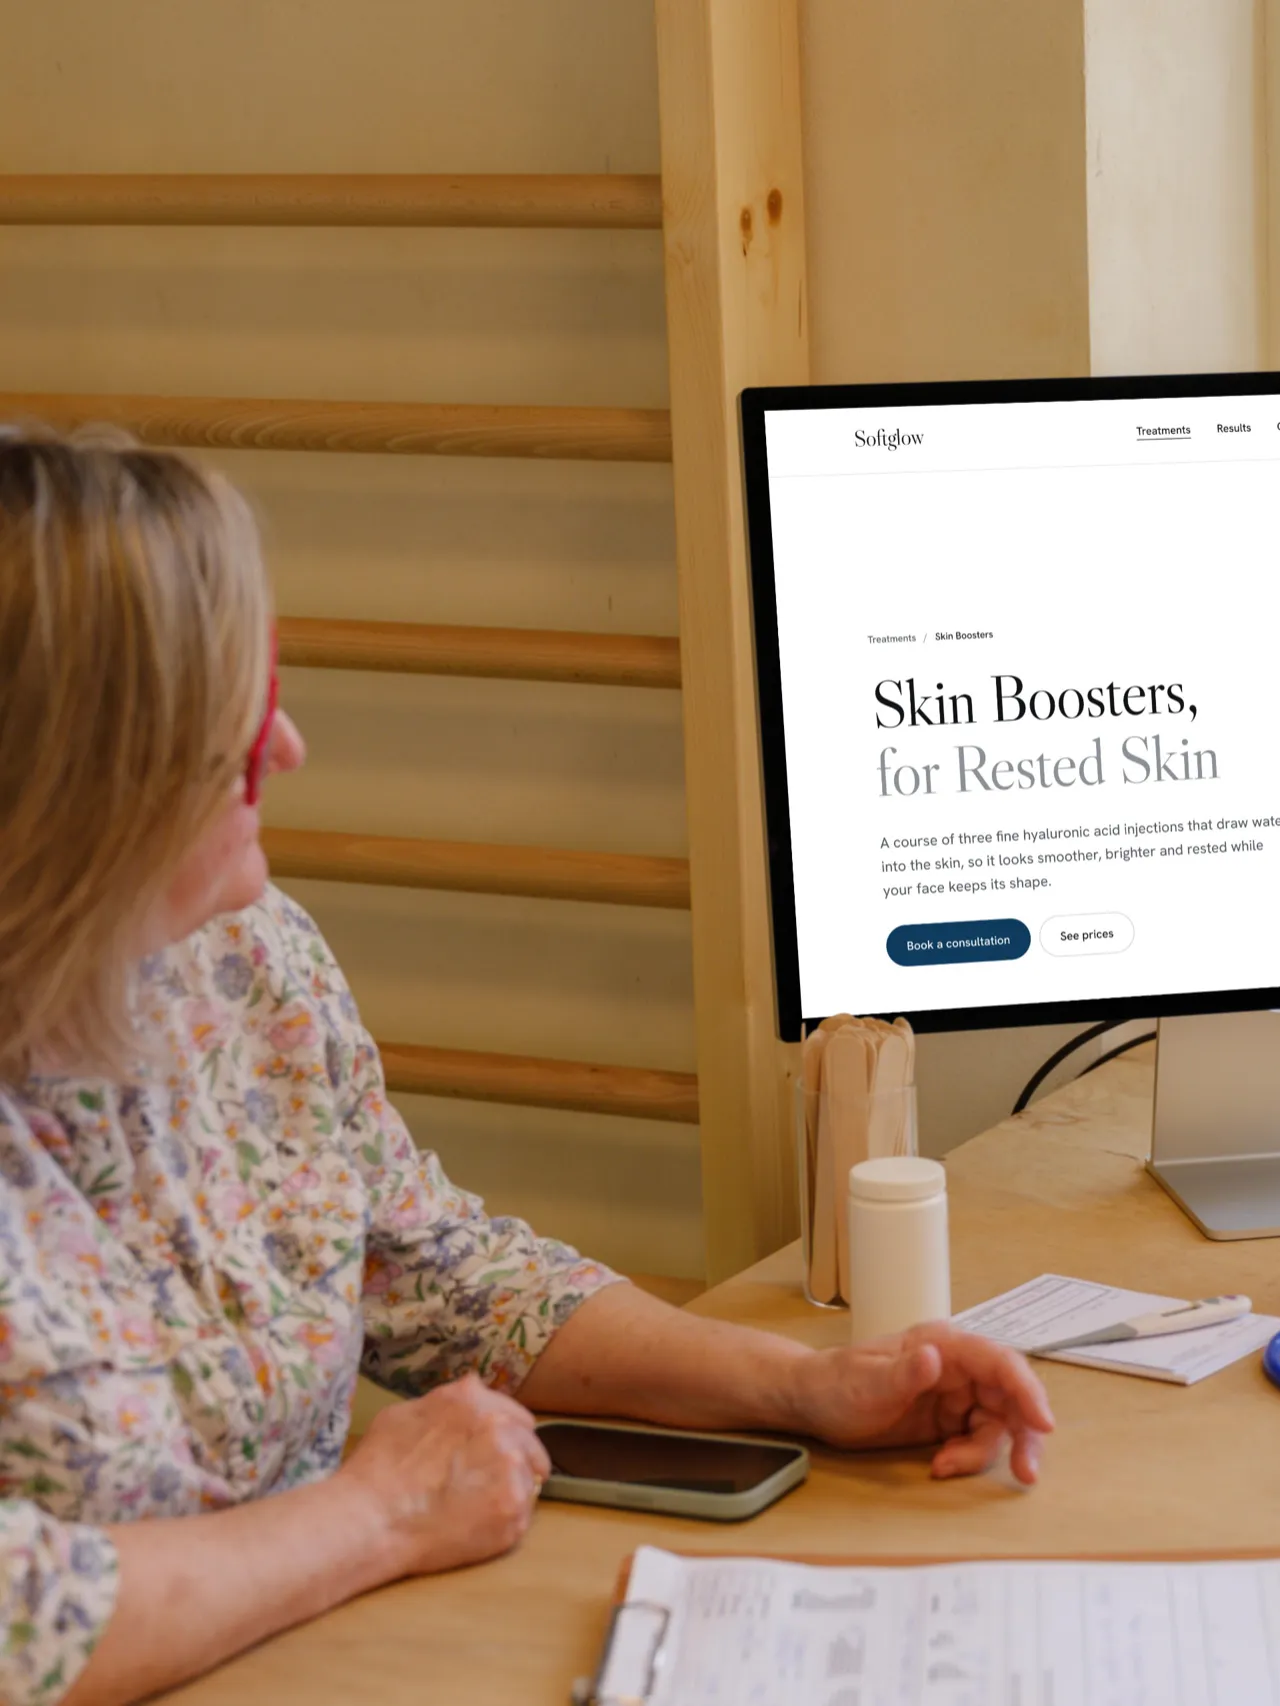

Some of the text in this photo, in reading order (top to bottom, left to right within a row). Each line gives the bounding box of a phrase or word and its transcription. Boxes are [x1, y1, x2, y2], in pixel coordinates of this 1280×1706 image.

[854, 427, 924, 452] Softglow
[1135, 425, 1191, 436] Treatments
[1216, 422, 1252, 434] Results
[867, 634, 917, 645] Treatments
[935, 631, 954, 641] Skin
[955, 631, 994, 641] Boosters
[875, 675, 1197, 729] Skin Boosters,
[877, 734, 1219, 796] for Rested Skin
[880, 836, 890, 850] A
[893, 836, 938, 849] course
[941, 832, 955, 846] of
[957, 832, 993, 845] three
[995, 829, 1020, 843] fine
[1023, 825, 1090, 844] hyaluronic
[1093, 823, 1121, 837] acid
[1123, 821, 1185, 838] injections
[1187, 819, 1214, 832] that
[1216, 817, 1249, 830] draw
[881, 839, 1264, 873] into the skin, so it looks smoother, brighter and rested while
[882, 876, 1052, 900] your face keeps its shape.
[906, 935, 1011, 951] Book a consultation
[1060, 929, 1115, 943] See prices
